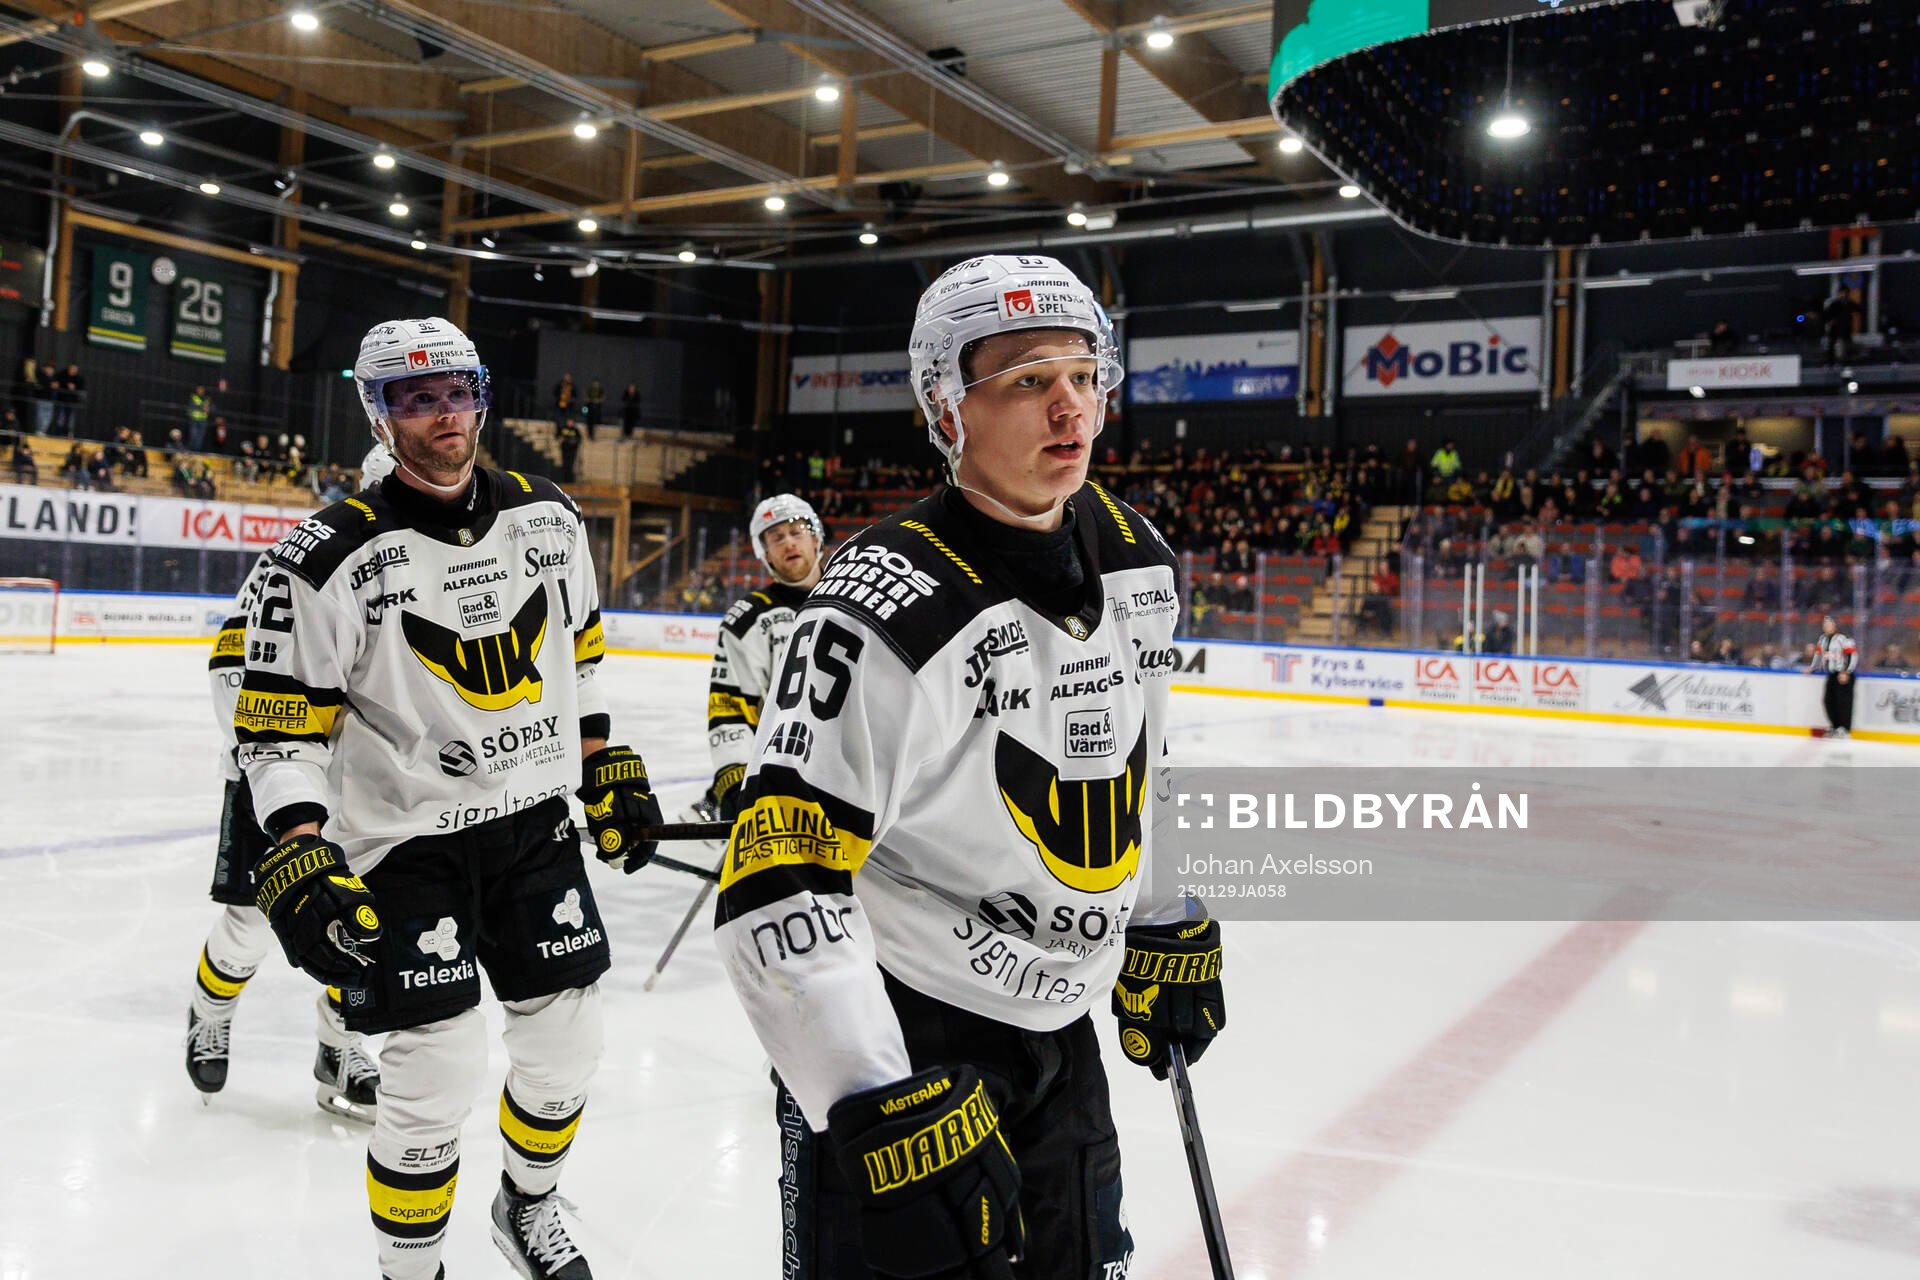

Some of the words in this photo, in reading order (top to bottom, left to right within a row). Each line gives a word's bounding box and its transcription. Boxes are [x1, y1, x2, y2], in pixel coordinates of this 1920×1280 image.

[108, 261, 133, 308] 9
[179, 277, 223, 325] 26
[1037, 292, 1086, 304] SVENSKA
[1039, 303, 1068, 314] SPEL
[429, 350, 464, 359] SVENSKA
[431, 358, 452, 367] SPEL
[1366, 334, 1528, 381] MoBic
[182, 508, 235, 541] ICA
[448, 557, 498, 574] WARRIOR
[833, 545, 941, 597] AROS
[443, 570, 508, 592] ALFAGLAS
[822, 563, 919, 608] INDUSTRI
[463, 603, 483, 614] Bad
[483, 594, 496, 609] &
[808, 579, 898, 621] PARTNER
[465, 608, 499, 625] Värme
[776, 619, 865, 721] 65
[1416, 656, 1459, 681] ICA
[1474, 660, 1519, 684] ICA
[1533, 665, 1579, 689] ICA
[1070, 722, 1100, 736] Bad
[1103, 711, 1112, 734] &
[481, 715, 559, 758] SÖRBY
[1070, 737, 1113, 753] Värme
[488, 757, 518, 775] JÄRN
[526, 741, 565, 762] METALL
[537, 927, 602, 960] Telexia
[1045, 938, 1093, 959] JÄRN
[399, 960, 477, 990] Telexia
[880, 1082, 943, 1116] VÄSTERÅS
